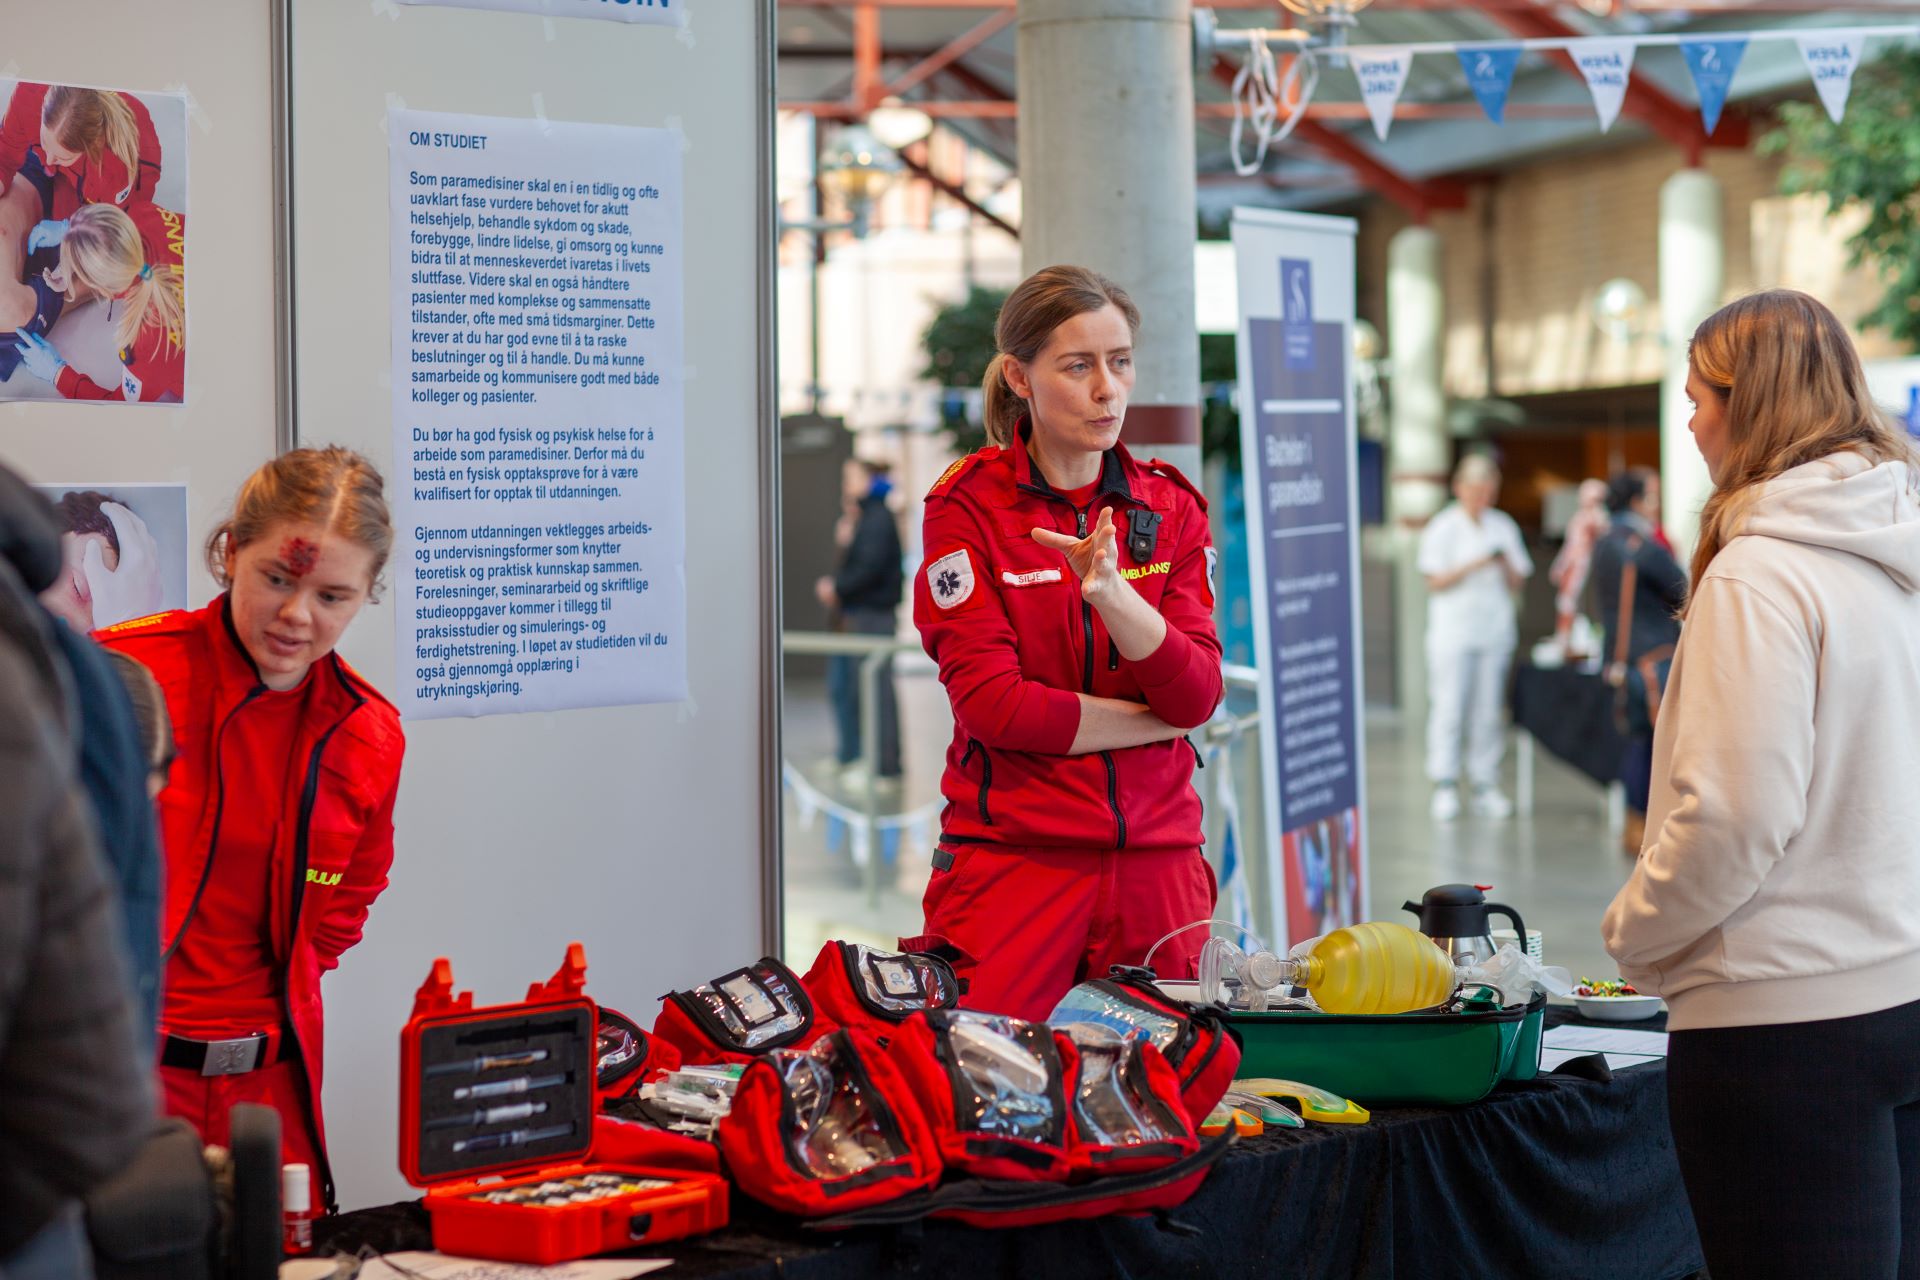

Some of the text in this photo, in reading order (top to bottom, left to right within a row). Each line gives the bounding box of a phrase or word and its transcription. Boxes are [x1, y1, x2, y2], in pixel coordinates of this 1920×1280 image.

[409, 131, 487, 150] OM STUDIET
[409, 170, 659, 201] Som paramedisiner skal en i en tidlig og ofte
[410, 191, 629, 216] uavklart fase vurdere behovet for akutt
[410, 210, 632, 236] helsehjelp, behandle sykdom og skade,
[410, 229, 664, 257] forebygge, lindre lidelse, gi omsorg og kunne
[411, 250, 651, 273] bidra til at menneskeverdet ivaretas i livets
[411, 269, 630, 292] sluttfase. Videre skal en også håndtere
[412, 290, 651, 311] pasienter med komplekse og sammensatte
[411, 309, 655, 331] tilstander, ofte med små tidsmarginer. Dette
[412, 329, 627, 348] krever at du har god evne til å ta raske
[411, 348, 645, 368] beslutninger og til å handle. Du må kunne
[411, 369, 660, 388] samarbeide og kommunisere godt med både
[412, 388, 536, 406] kolleger og pasienter.
[413, 446, 644, 464] arbeide som paramedisiner. Derfor må du
[413, 464, 638, 484] bestå en fysisk opptaksprøve for å være
[414, 484, 621, 502] kvalifisert for opptak til utdanningen.
[414, 521, 652, 544] Gjennom utdanningen vektlegges arbeids-
[415, 541, 621, 563] og undervisningsformer som knytter
[415, 561, 642, 581] teoretisk og praktisk kunnskap sammen.
[1018, 572, 1042, 583] SILJE
[416, 577, 648, 601] Forelesninger, seminararbeid og skriftlige
[416, 597, 611, 621] studieoppgaver kommer i tillegg til
[416, 618, 606, 642] praksisstudier og simulerings- og
[416, 632, 668, 661] ferdighetstrening. I løpet av studietiden vil du
[416, 655, 579, 682] også gjennomgå opplæring i
[416, 679, 522, 701] utrykningskjøring.
